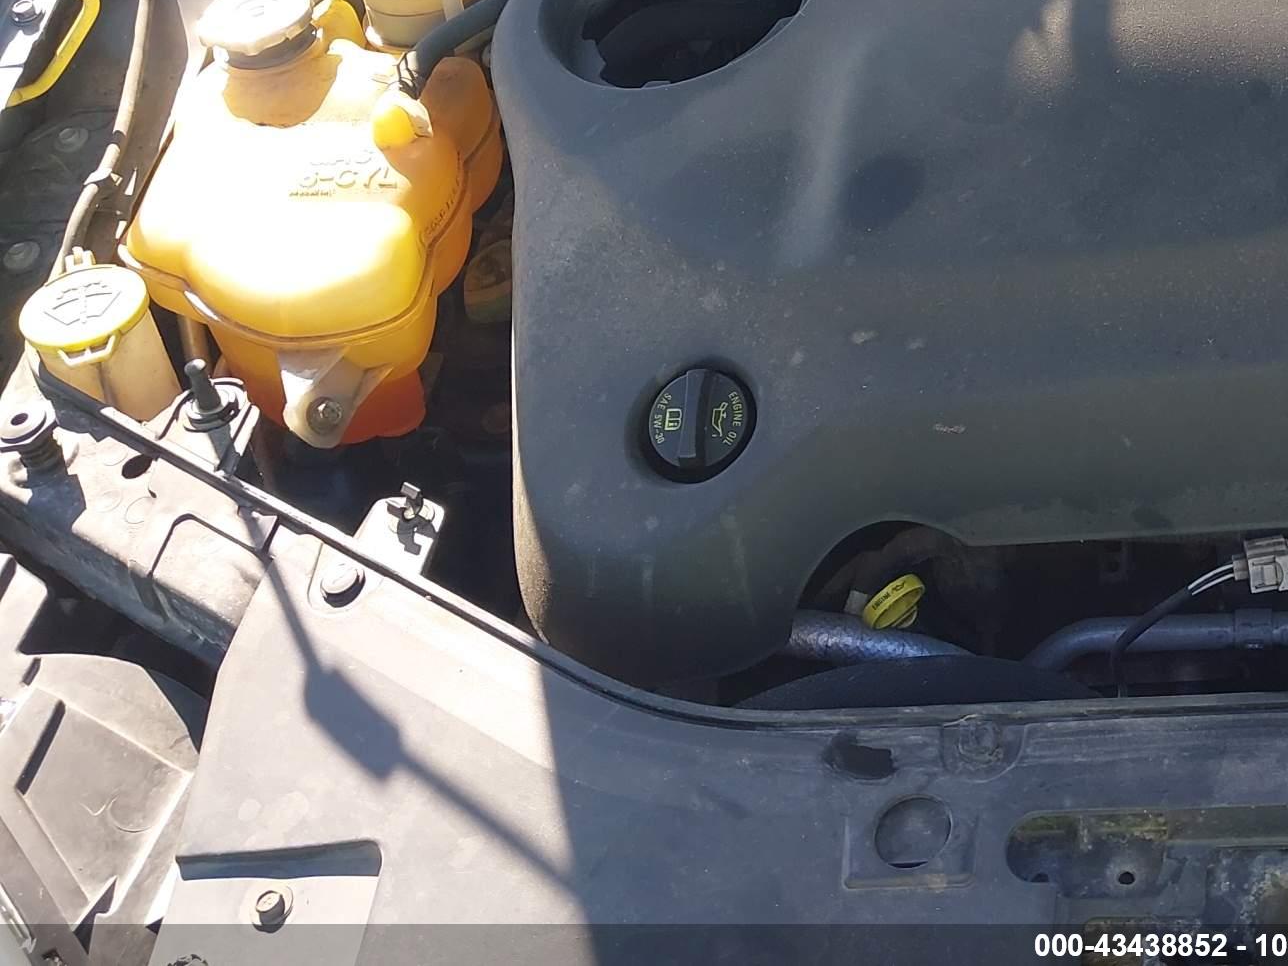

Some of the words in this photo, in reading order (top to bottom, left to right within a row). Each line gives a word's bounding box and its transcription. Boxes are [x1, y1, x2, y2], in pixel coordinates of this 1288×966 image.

[657, 392, 672, 410] SAE
[728, 391, 744, 428] ENGINE
[653, 414, 665, 445] 5W-30
[722, 431, 737, 446] OIL
